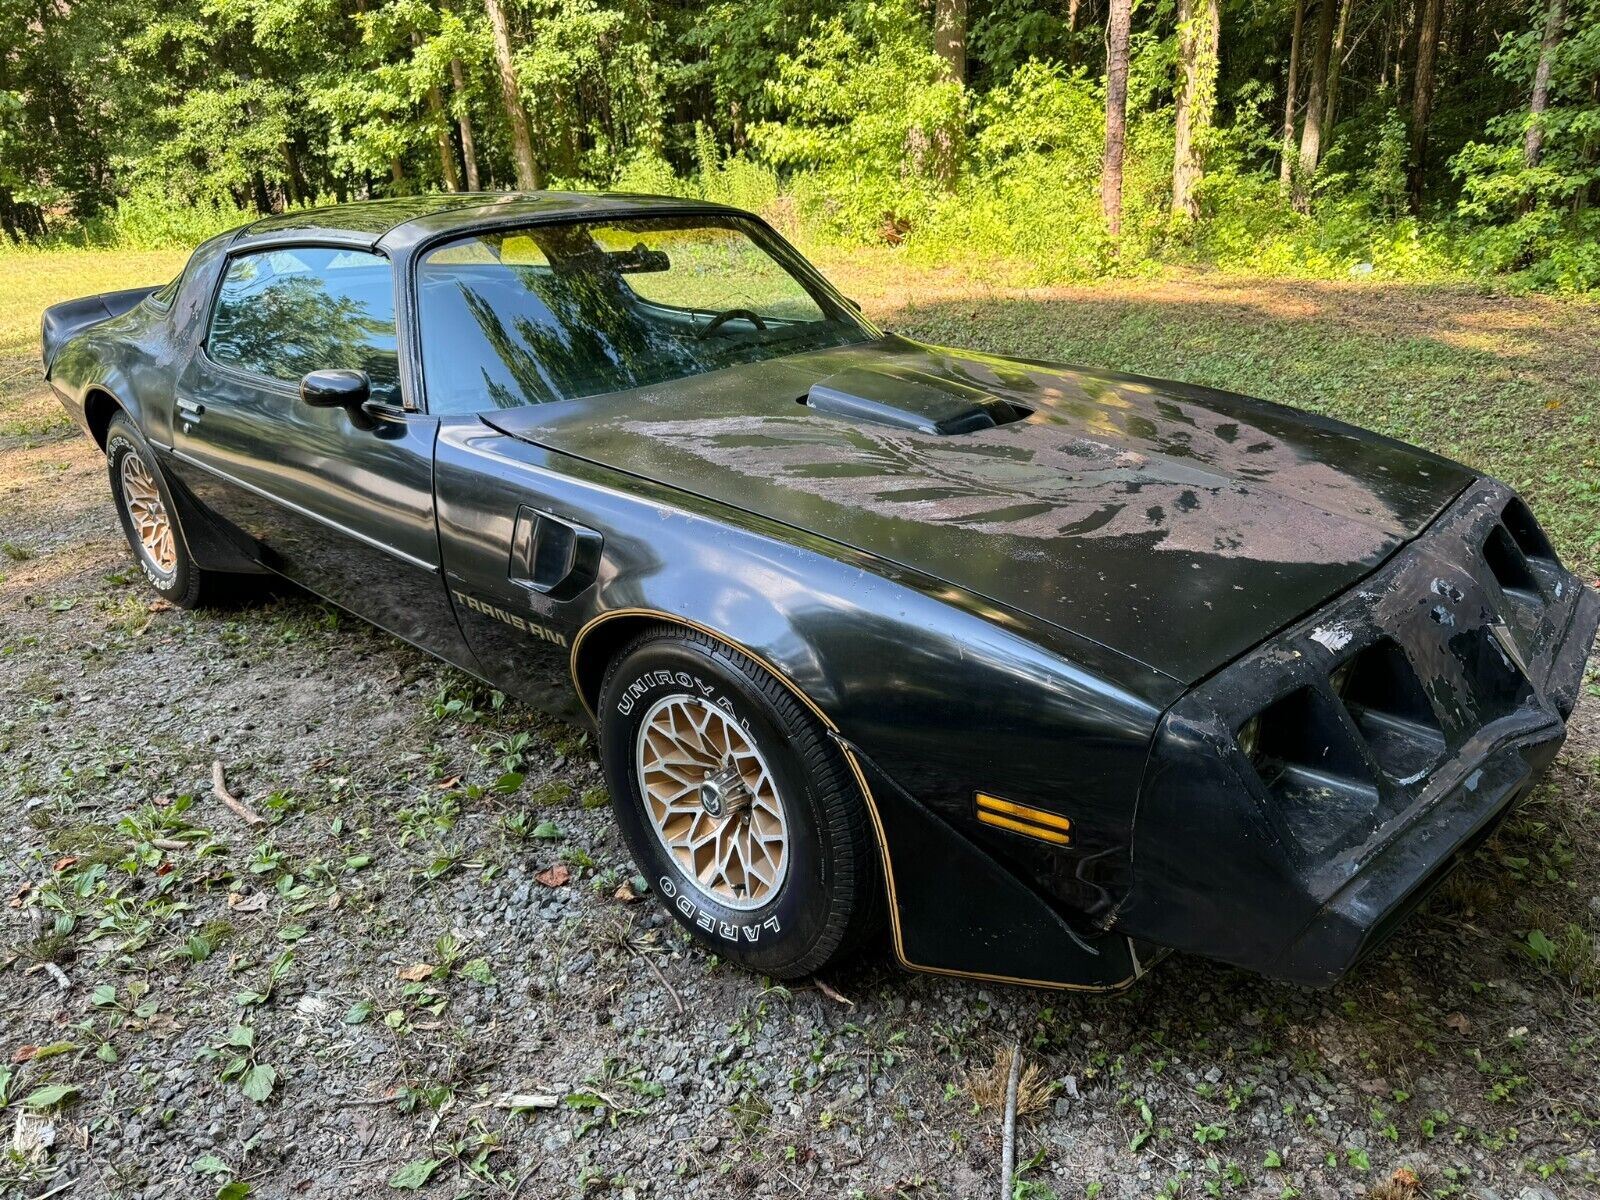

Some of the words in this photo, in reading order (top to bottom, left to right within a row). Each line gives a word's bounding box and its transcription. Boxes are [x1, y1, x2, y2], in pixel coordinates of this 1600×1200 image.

[452, 589, 526, 630] TRANS
[530, 621, 567, 648] AM
[617, 670, 757, 744] UNIROYAL
[660, 876, 780, 941] LAREDO
